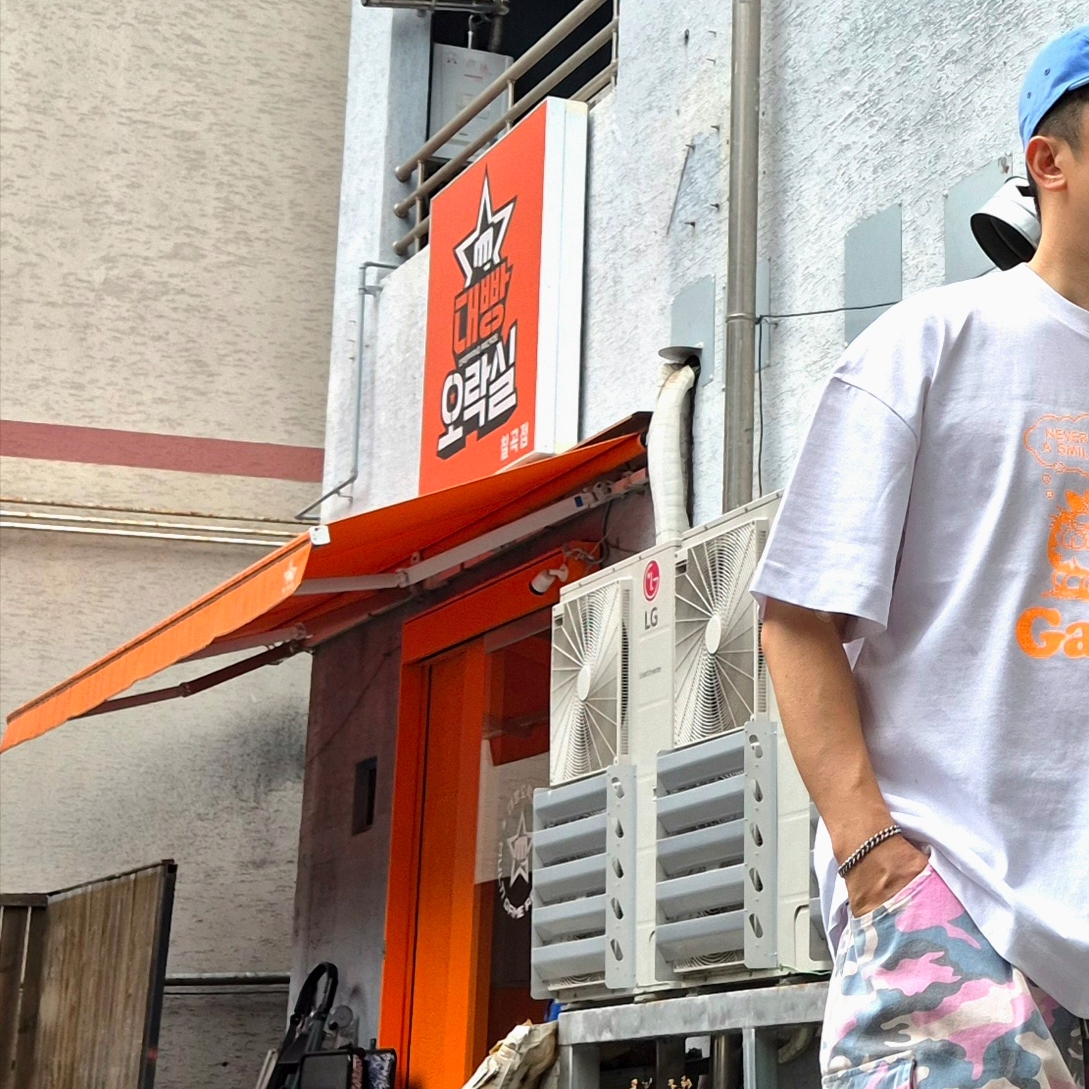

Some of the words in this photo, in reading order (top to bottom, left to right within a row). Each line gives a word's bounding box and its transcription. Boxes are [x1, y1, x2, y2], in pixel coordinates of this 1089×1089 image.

[453, 262, 511, 355] 대빵
[437, 324, 517, 452] 오락실
[1042, 441, 1052, 453] A
[1045, 427, 1088, 444] NEVER
[644, 606, 659, 631] LG
